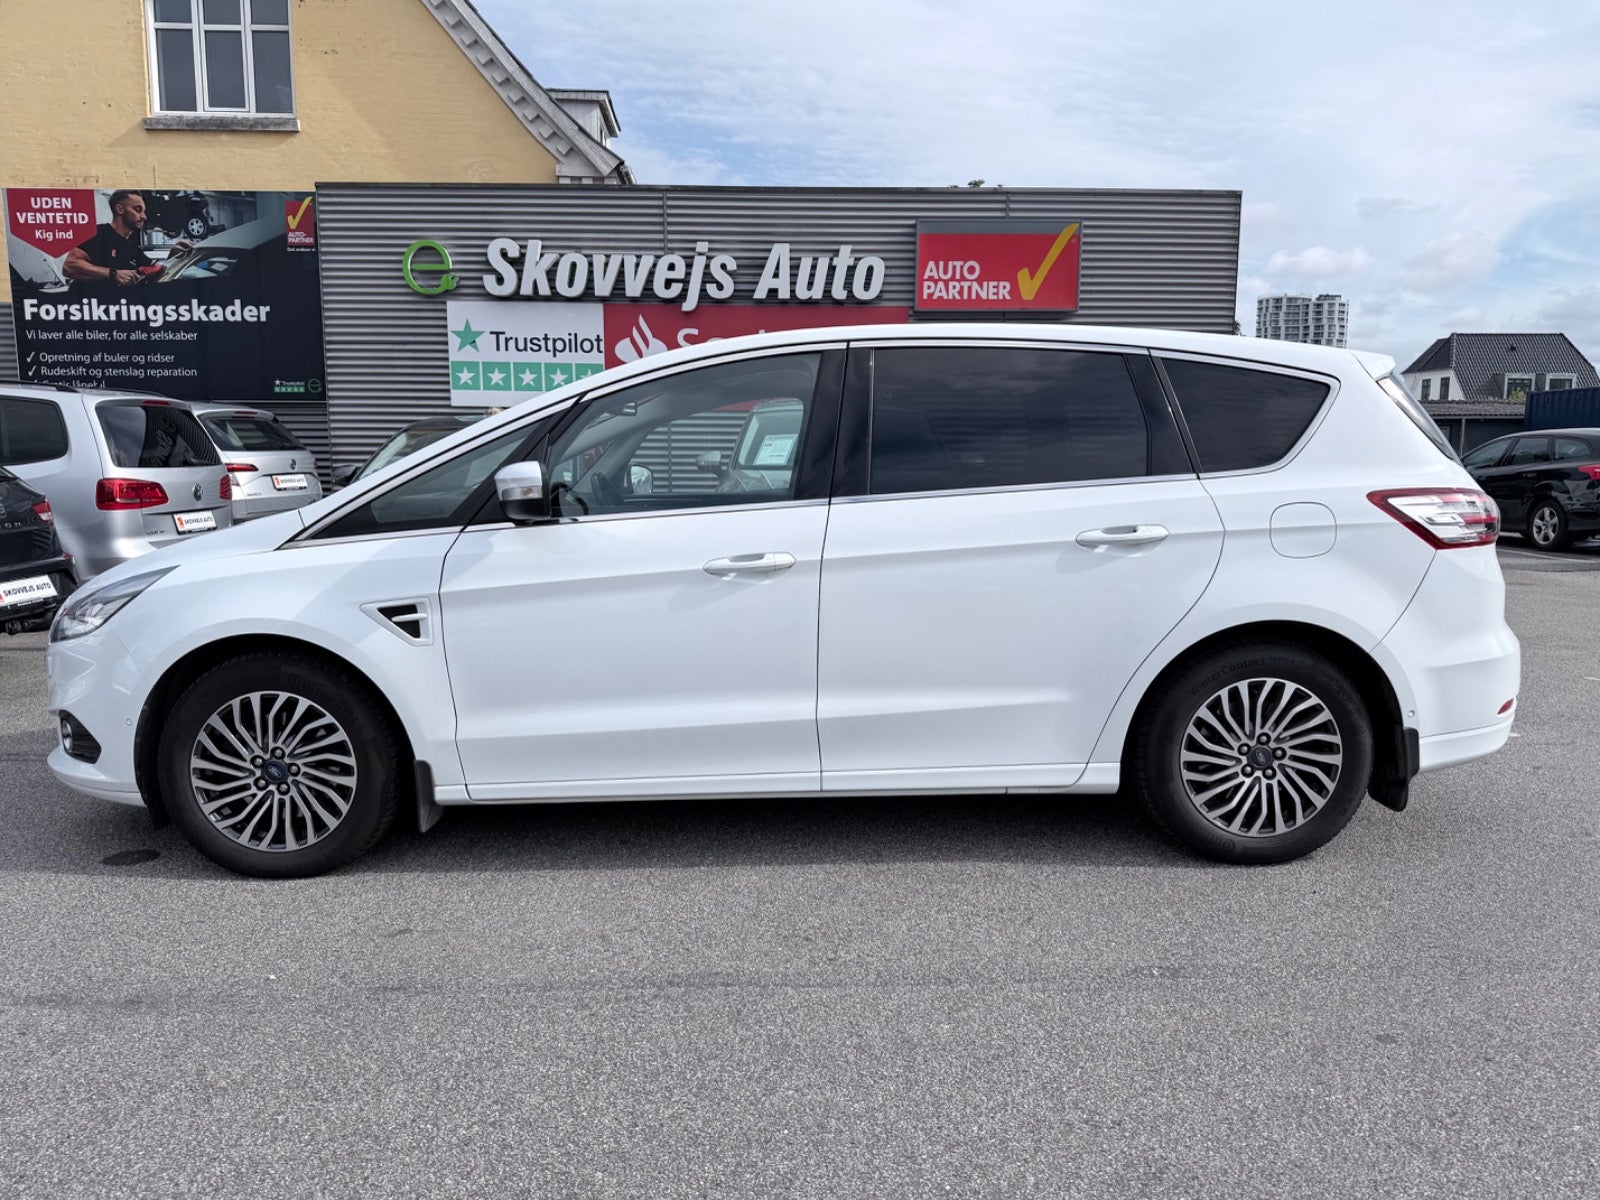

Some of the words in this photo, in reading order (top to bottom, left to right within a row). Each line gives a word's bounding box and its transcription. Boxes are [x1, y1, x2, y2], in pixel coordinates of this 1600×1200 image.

[30, 197, 72, 209] UDEN
[16, 212, 89, 224] VENTETID
[35, 229, 53, 242] Kig
[55, 229, 73, 239] ind
[482, 237, 738, 312] Skovvejs
[752, 242, 886, 302] Auto
[923, 260, 981, 280] AUTO
[922, 281, 1012, 300] PARTNER
[22, 298, 270, 327] Forsikringsskader
[26, 330, 36, 340] Vi
[38, 330, 63, 340] laver
[65, 330, 84, 340] alle
[86, 330, 111, 341] biler,
[112, 330, 127, 340] for
[129, 331, 148, 341] alle
[150, 331, 198, 341] selskaber
[490, 331, 604, 360] Trustpilot
[39, 352, 90, 364] Opretning
[92, 352, 102, 362] af
[104, 352, 129, 362] buler
[132, 354, 145, 364] og
[147, 352, 175, 362] ridser
[41, 366, 86, 376] Rudeskift
[89, 368, 102, 378] og
[104, 366, 145, 378] stenslag
[147, 366, 197, 378] reparation
[3, 584, 35, 597] SKOVVEJS
[36, 582, 52, 591] AUTO
